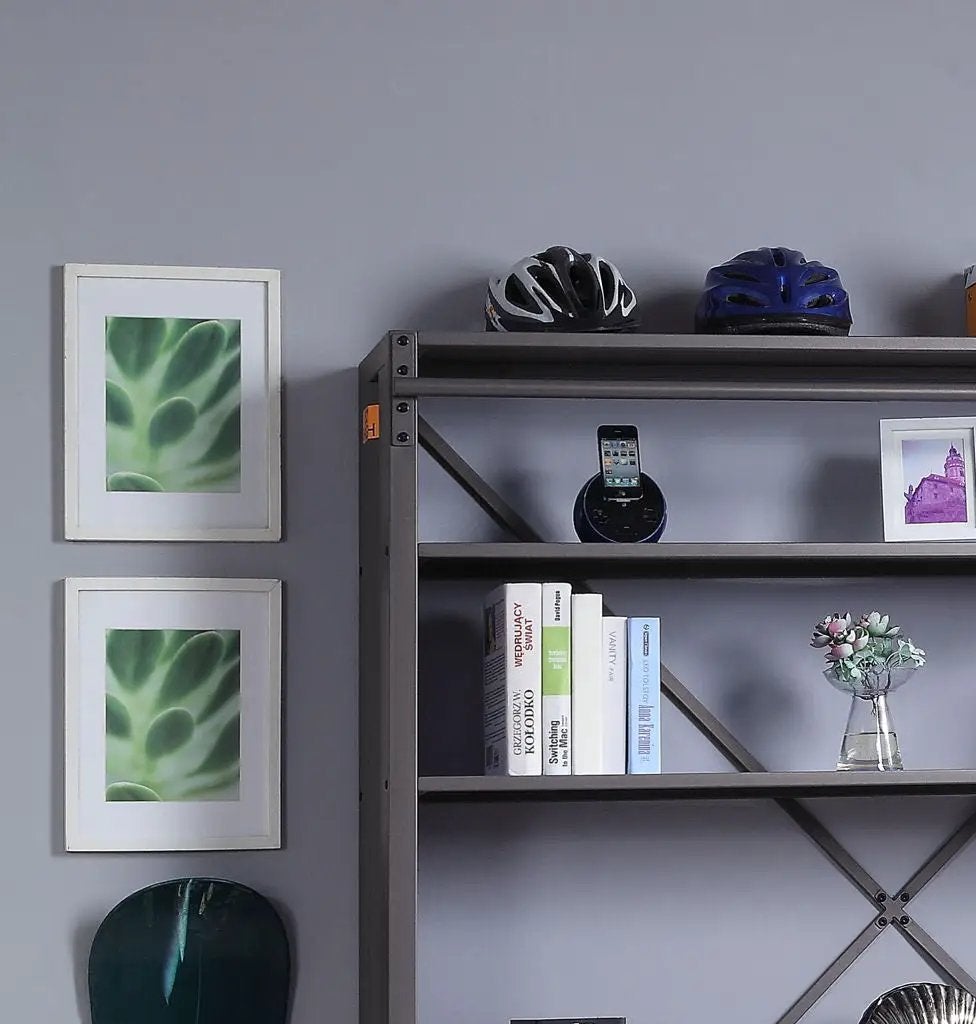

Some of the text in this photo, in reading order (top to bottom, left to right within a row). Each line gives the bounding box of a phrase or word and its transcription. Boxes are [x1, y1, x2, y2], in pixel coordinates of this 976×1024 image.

[513, 602, 524, 668] WĘDRUJĄCY
[524, 617, 534, 651] ŚWIAT
[608, 631, 616, 665] VANITY
[512, 702, 522, 756] GRZEGORZ
[524, 689, 535, 755] KOŁODKO
[560, 728, 569, 749] Mac
[548, 720, 561, 765] Switching
[561, 749, 569, 760] the
